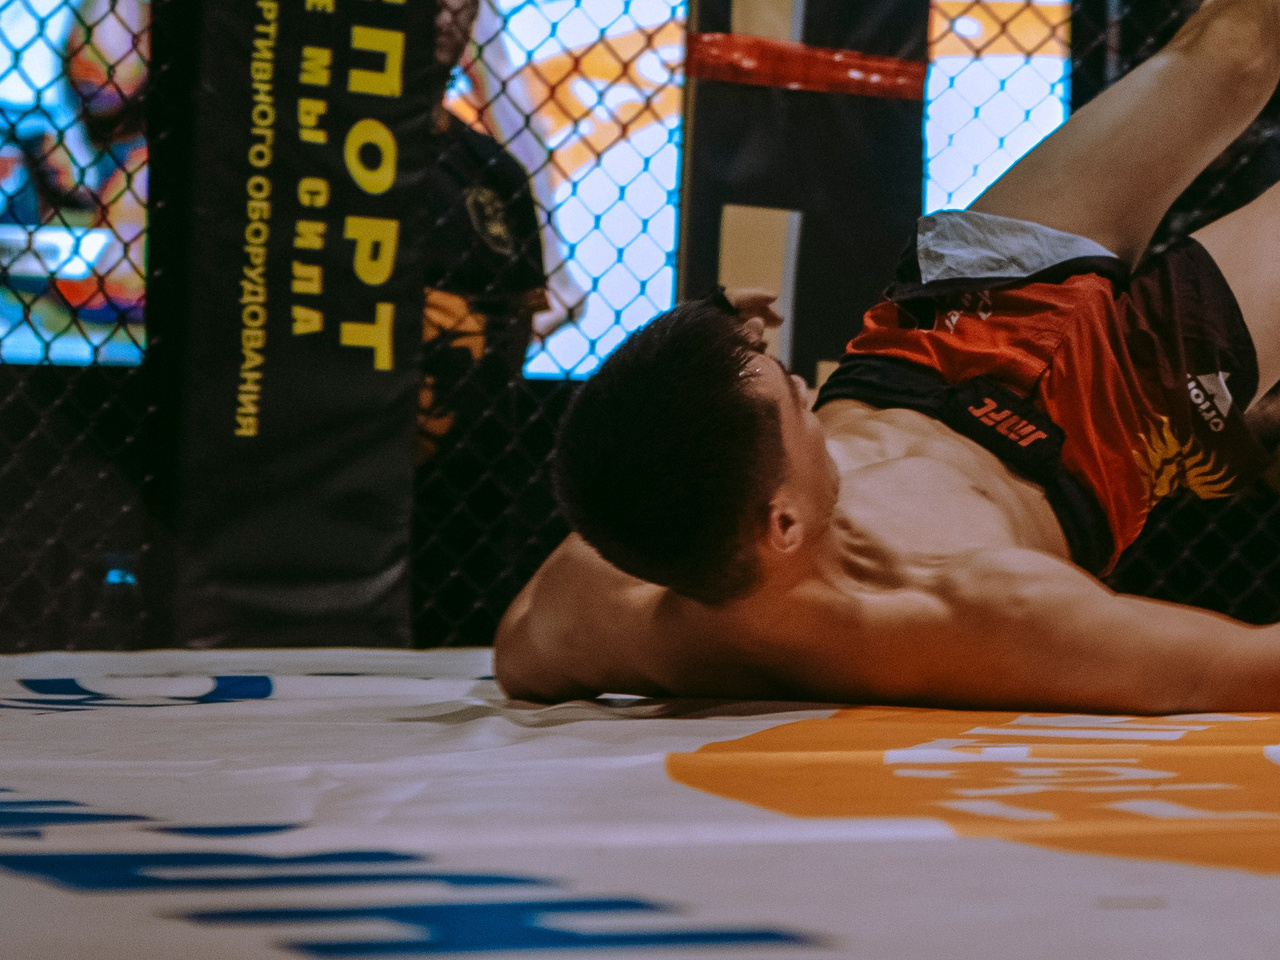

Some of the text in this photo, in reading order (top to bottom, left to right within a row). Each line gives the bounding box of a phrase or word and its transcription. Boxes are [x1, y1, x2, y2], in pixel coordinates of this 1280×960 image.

[298, 46, 332, 144] МЫ
[234, 175, 272, 437] ОБОРУДОВАНИЯ
[290, 176, 330, 335] СИЛА
